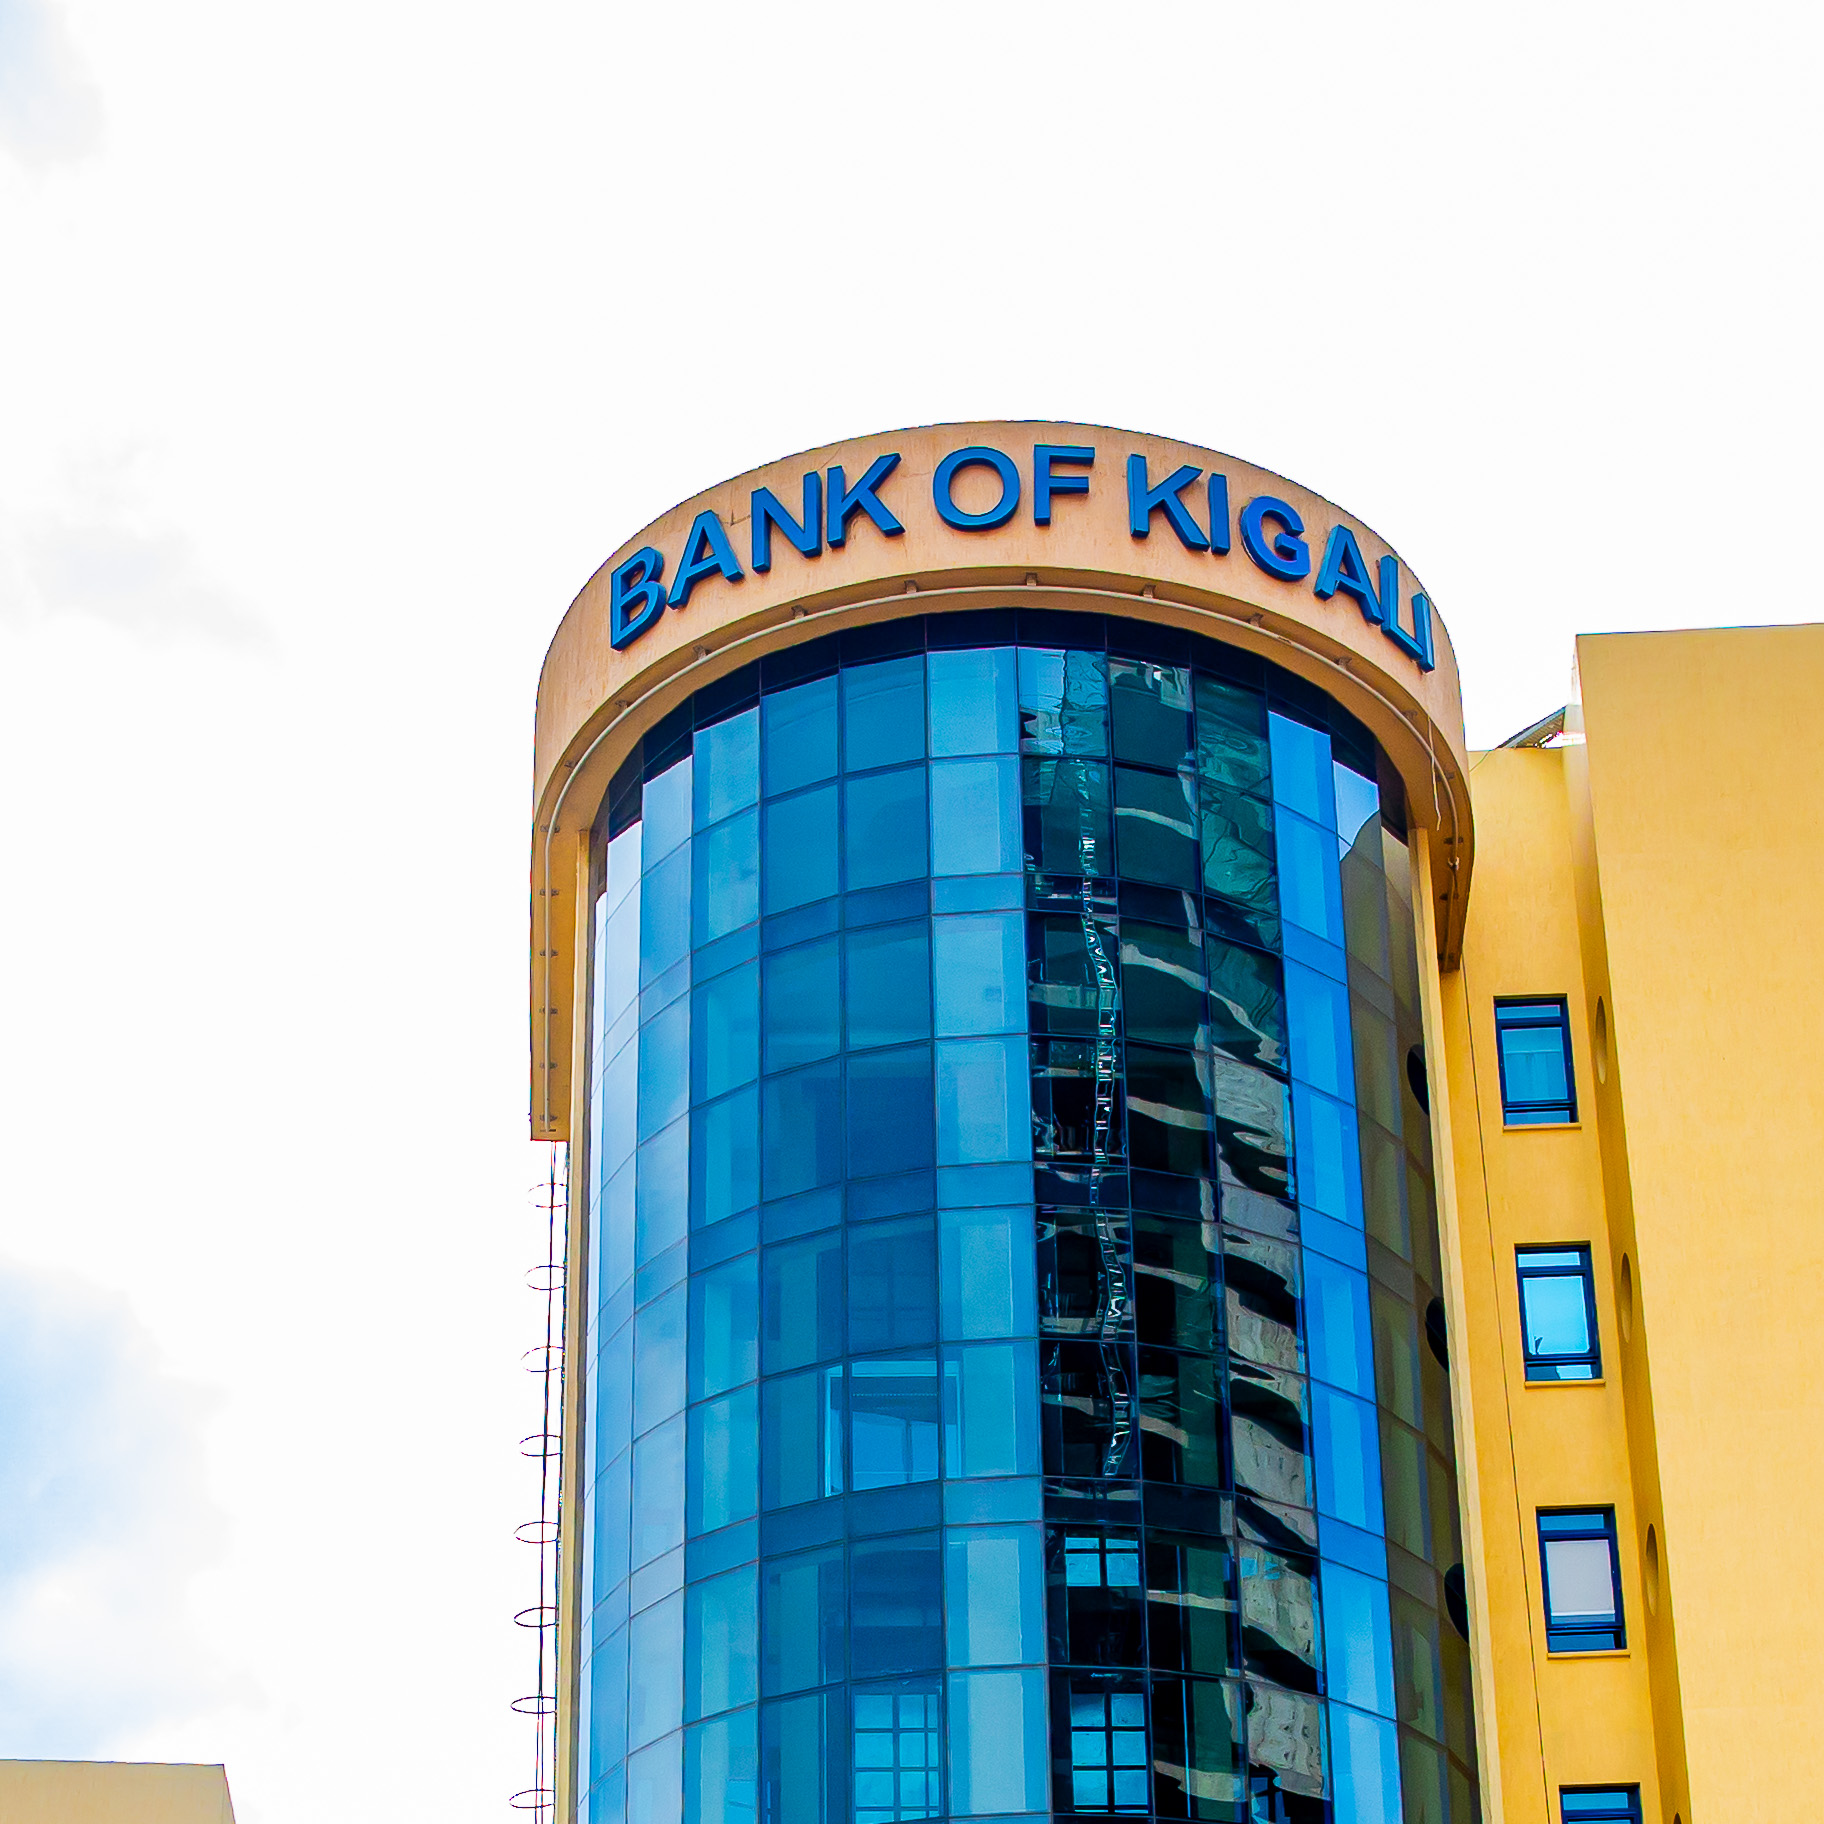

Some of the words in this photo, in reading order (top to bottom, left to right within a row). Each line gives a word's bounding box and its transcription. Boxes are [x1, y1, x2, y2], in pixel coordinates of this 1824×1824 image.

[610, 453, 905, 651] BANK
[933, 445, 1095, 531] OF
[1127, 454, 1435, 672] KIGALI
